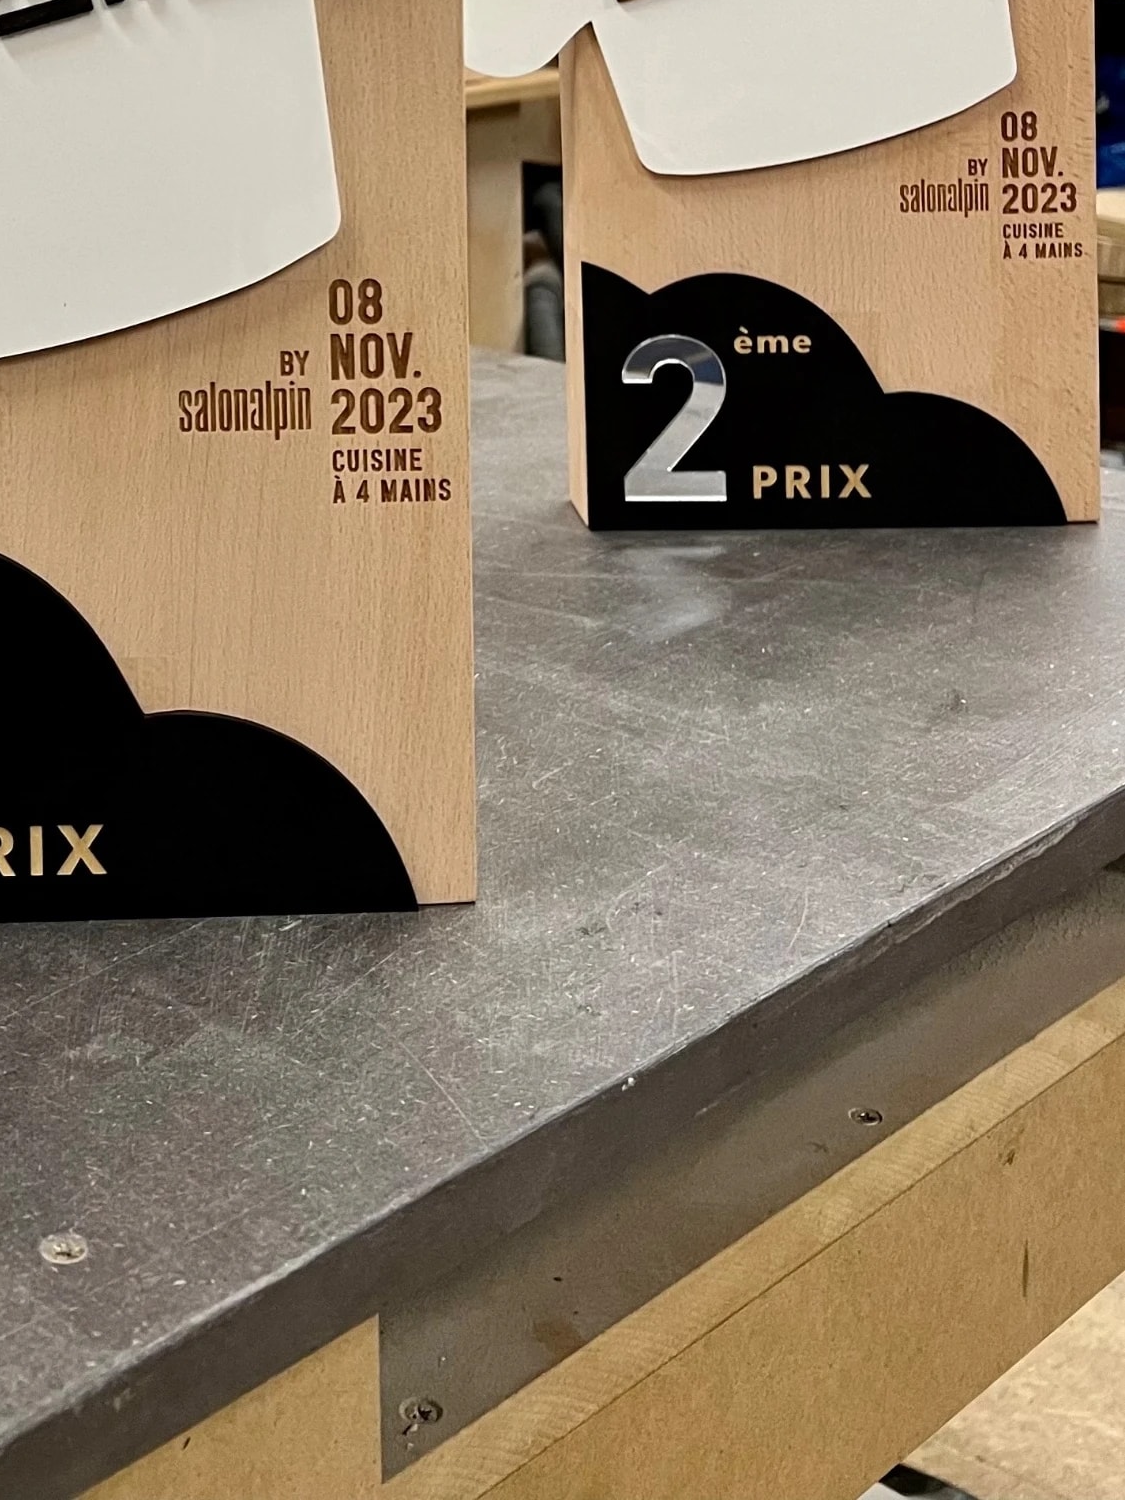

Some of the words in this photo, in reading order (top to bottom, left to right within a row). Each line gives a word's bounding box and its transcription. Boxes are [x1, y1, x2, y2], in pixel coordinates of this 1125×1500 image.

[1000, 110, 1038, 143] 08
[967, 158, 989, 177] BY
[1000, 146, 1064, 179] NOV.
[899, 178, 989, 218] salonalpin
[1001, 182, 1077, 215] 2023
[1001, 222, 1064, 240] CUISINE
[1002, 239, 1013, 260] À
[1018, 242, 1029, 260] 4
[1034, 241, 1084, 260] MAINS
[328, 278, 383, 326] 08
[279, 350, 310, 377] BY
[329, 331, 422, 381] NOV.
[177, 379, 312, 441] salonalpin
[330, 386, 443, 435] 2023
[620, 333, 728, 502] 2
[733, 326, 812, 354] ème
[331, 448, 423, 473] CUISINE
[332, 474, 347, 504] À
[356, 479, 370, 504] 4
[380, 477, 452, 503] MAINS
[751, 463, 873, 500] PRIX
